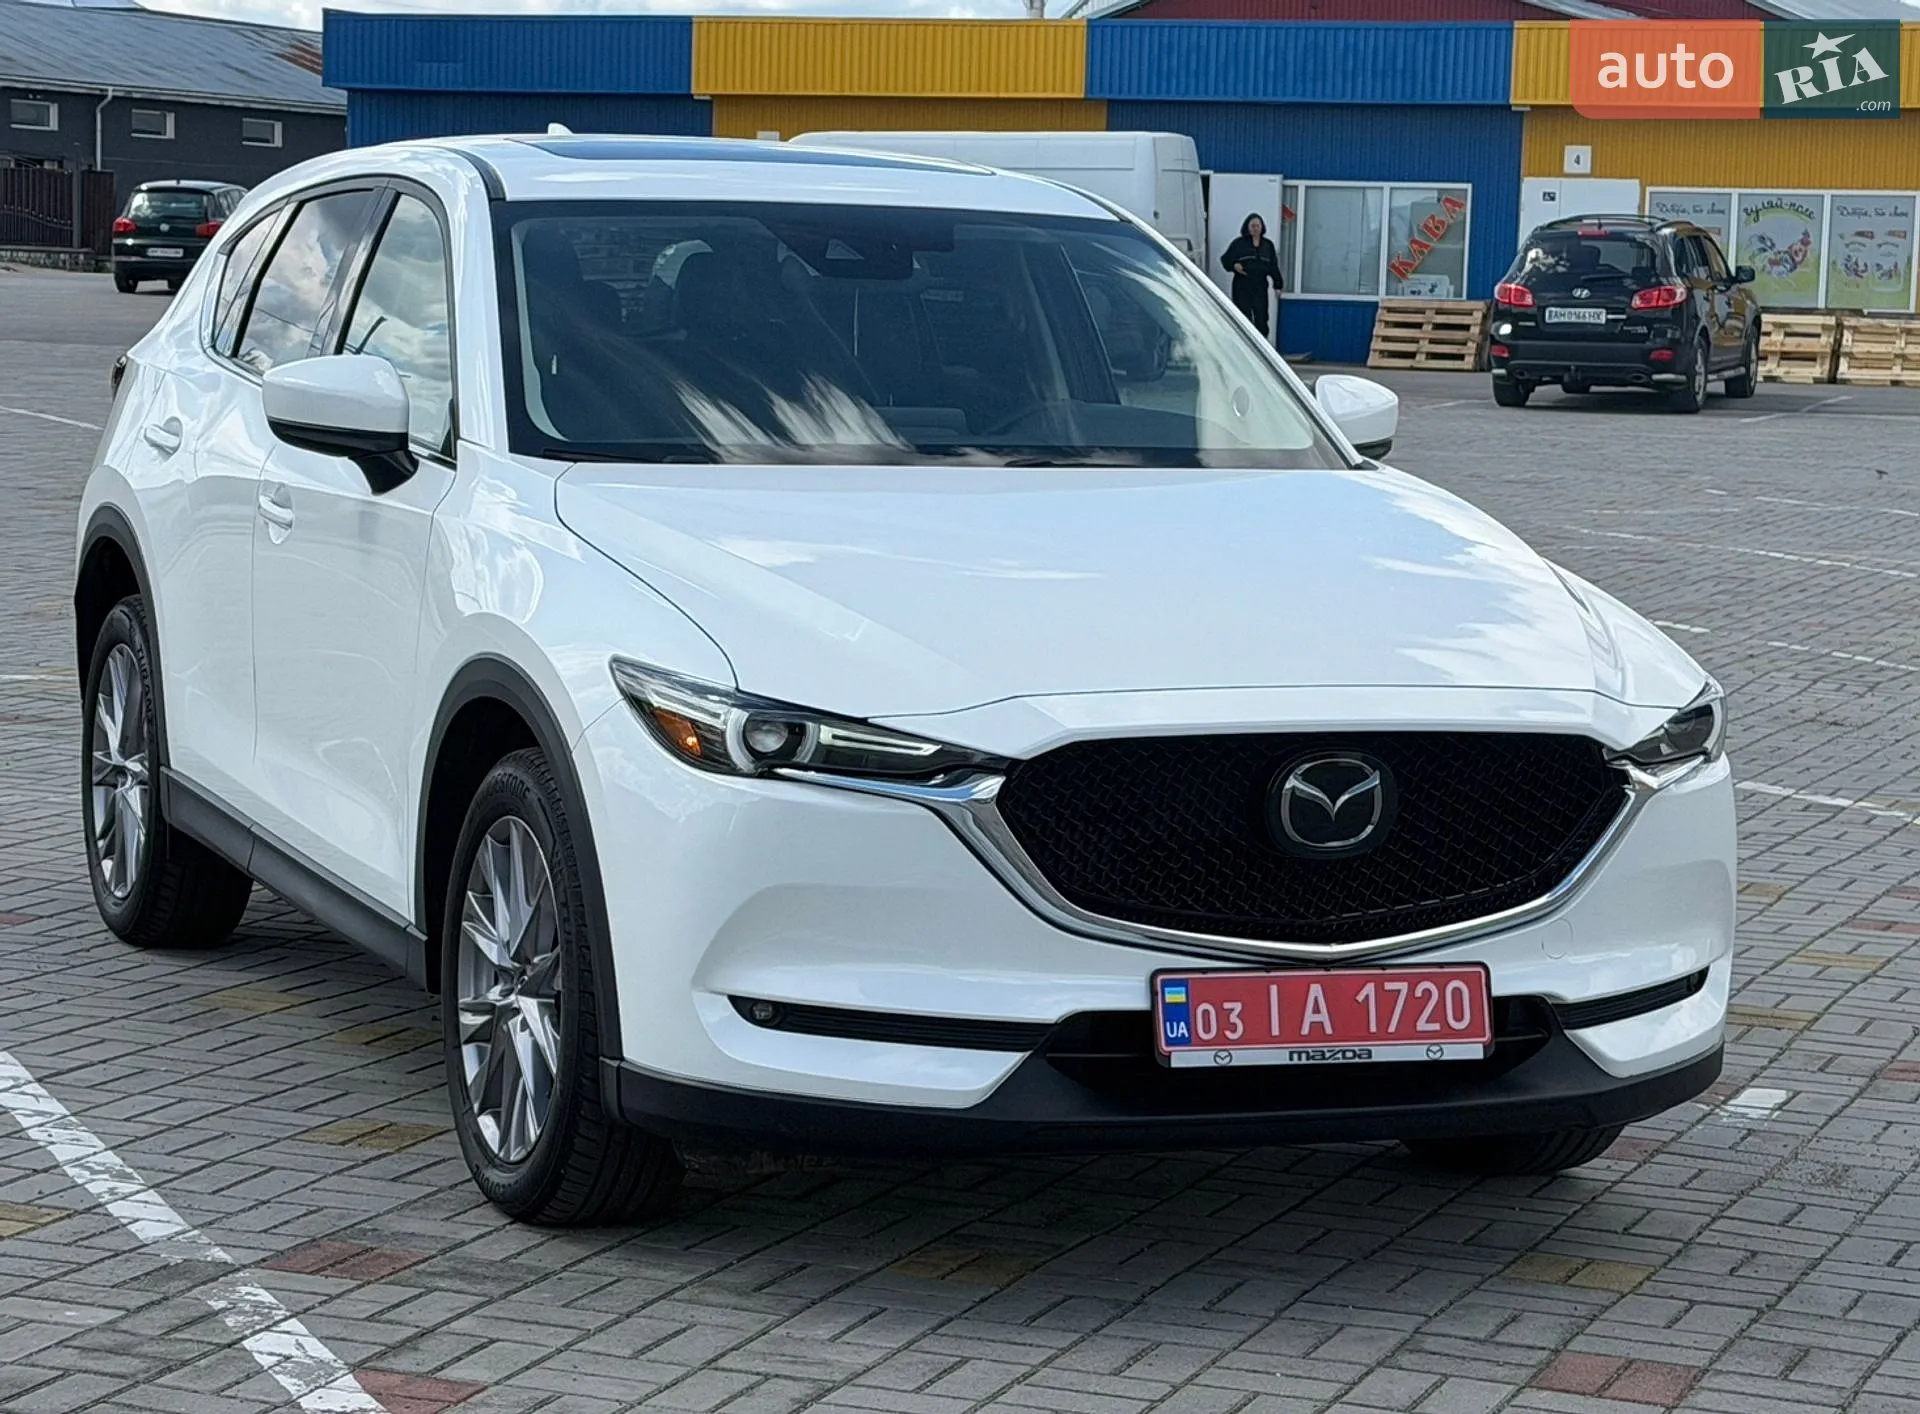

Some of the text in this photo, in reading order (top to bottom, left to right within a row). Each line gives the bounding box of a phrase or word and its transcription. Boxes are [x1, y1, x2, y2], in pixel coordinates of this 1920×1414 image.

[1573, 153, 1581, 166] 4
[1388, 195, 1466, 283] КАВА
[1166, 1021, 1190, 1039] UA
[1195, 1002, 1244, 1041] 03
[1355, 979, 1472, 1035] 1720
